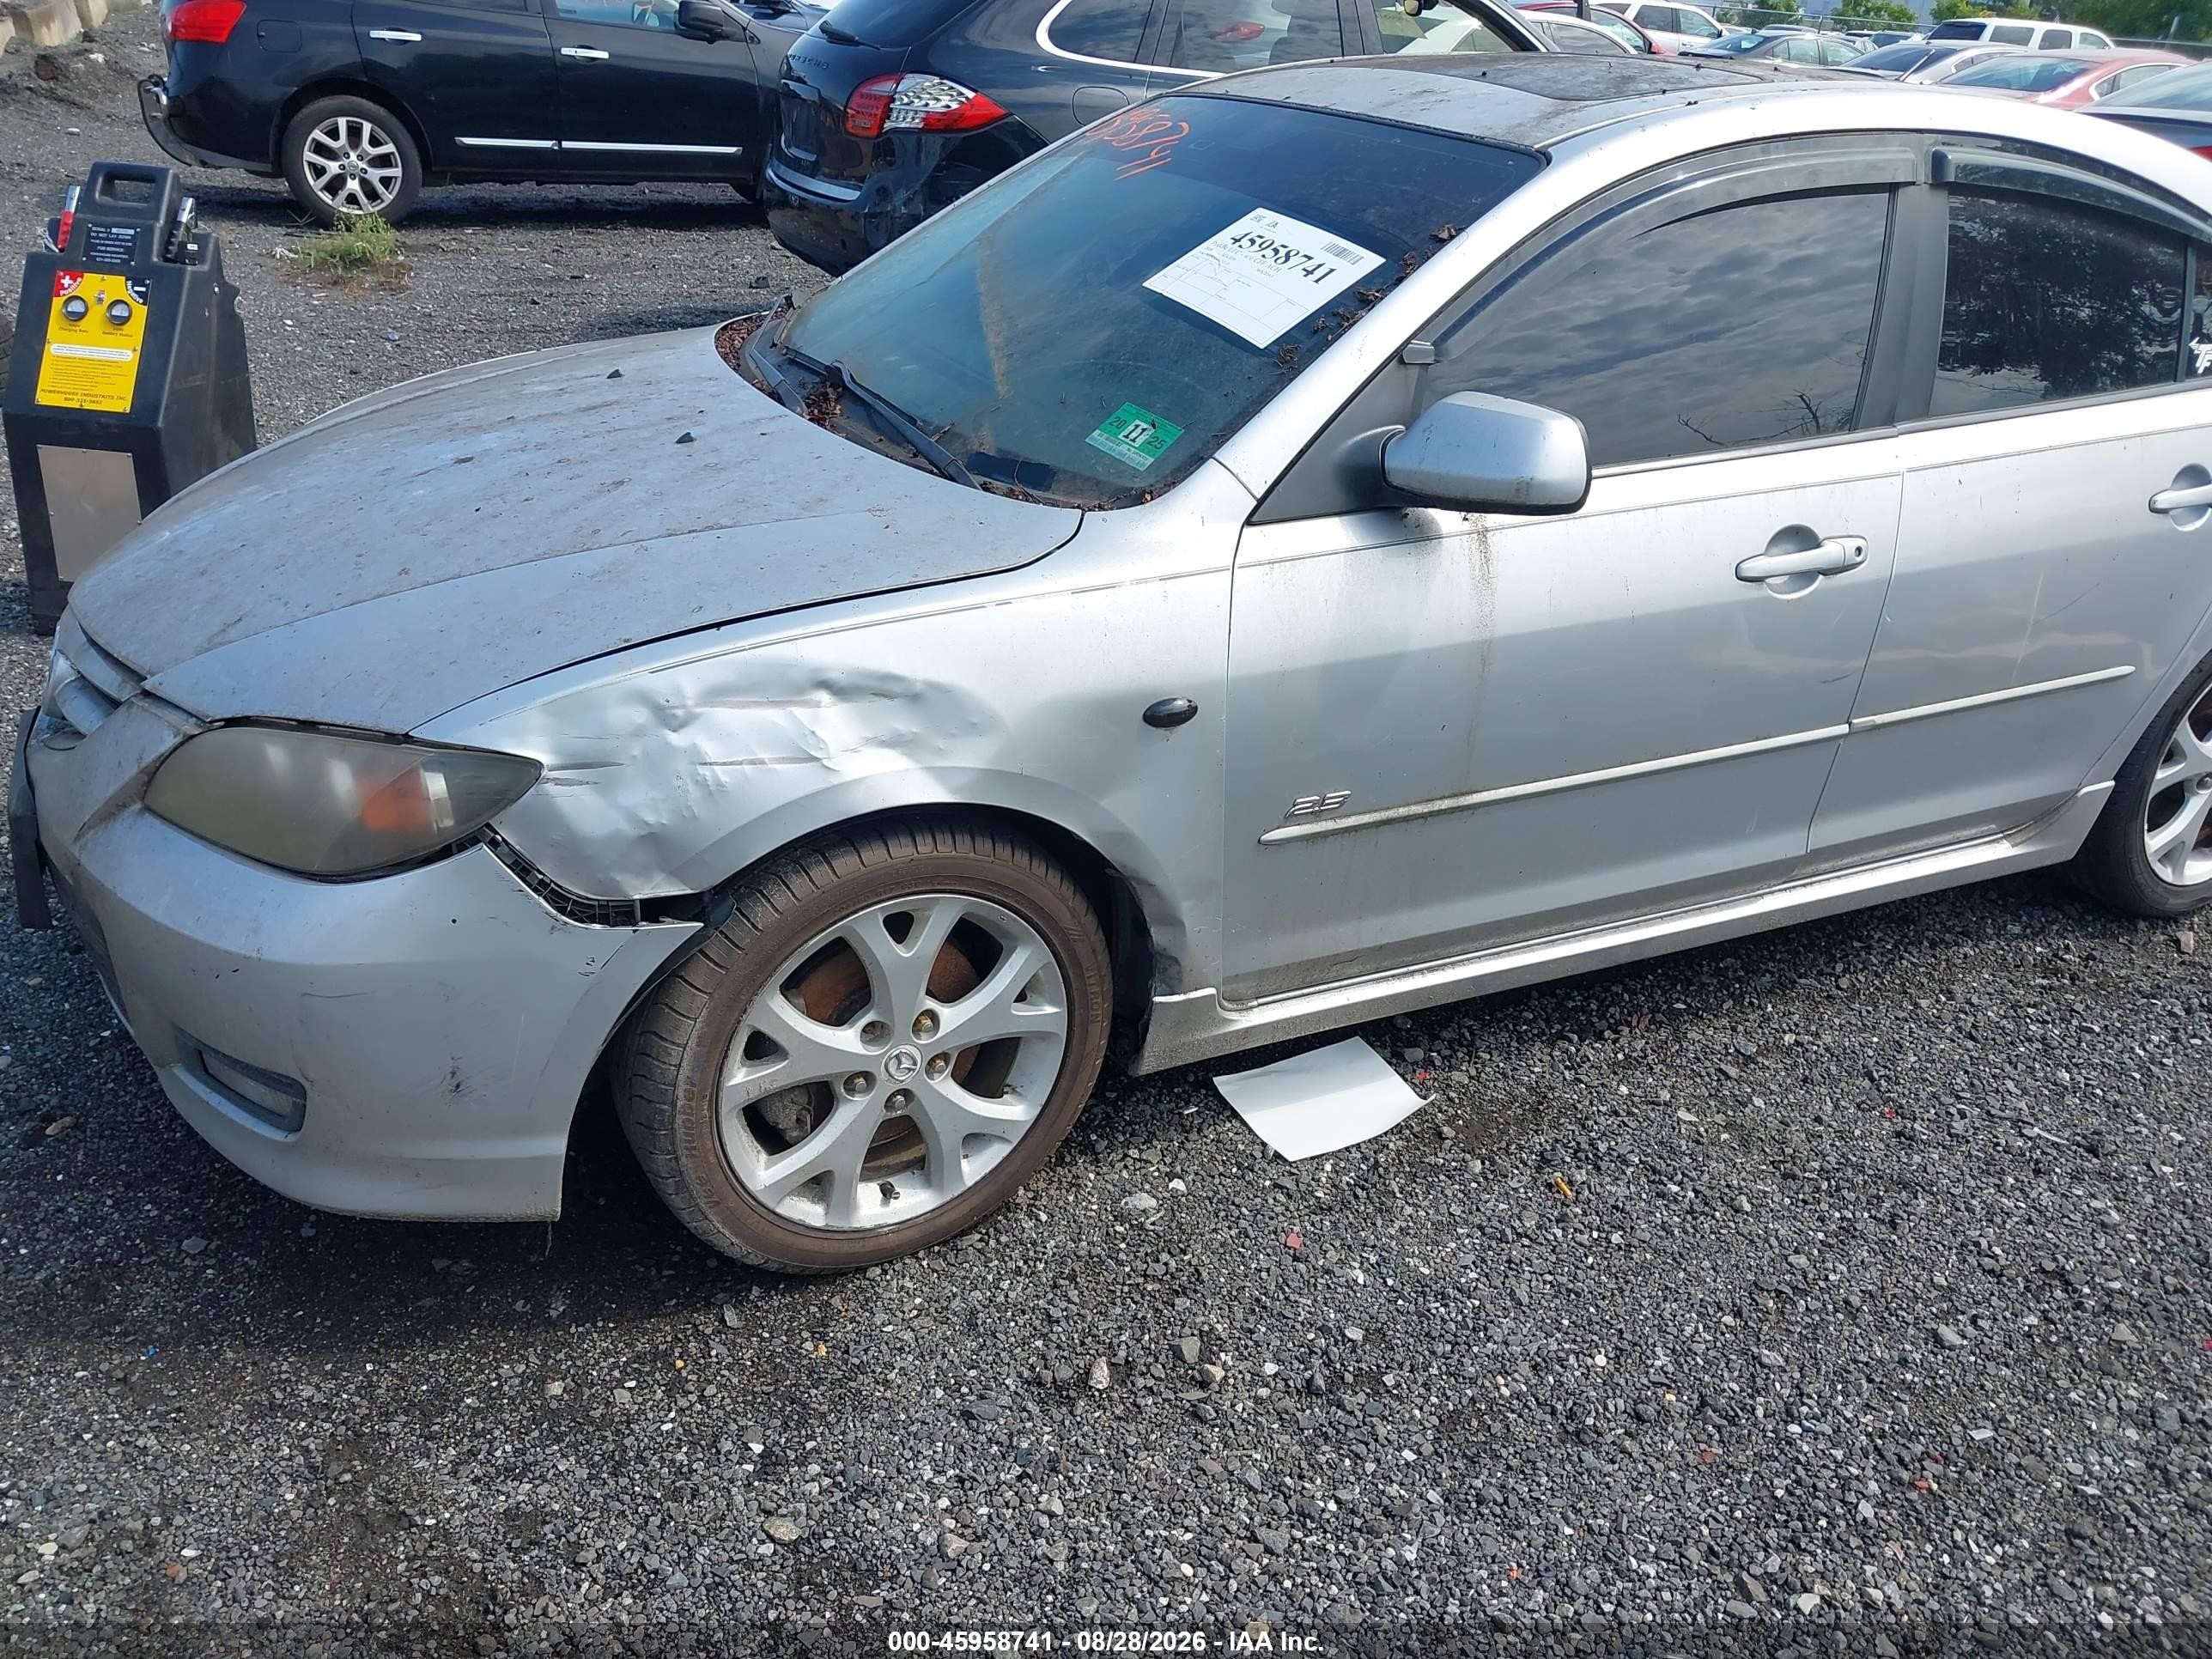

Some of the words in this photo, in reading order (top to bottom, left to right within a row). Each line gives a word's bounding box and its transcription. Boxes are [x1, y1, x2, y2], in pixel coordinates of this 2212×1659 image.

[1230, 230, 1338, 285] 45958741
[59, 277, 83, 296] Positive
[126, 280, 143, 304] Negative
[1109, 416, 1127, 429] 20
[1122, 423, 1148, 444] 11
[1147, 435, 1167, 450] 25
